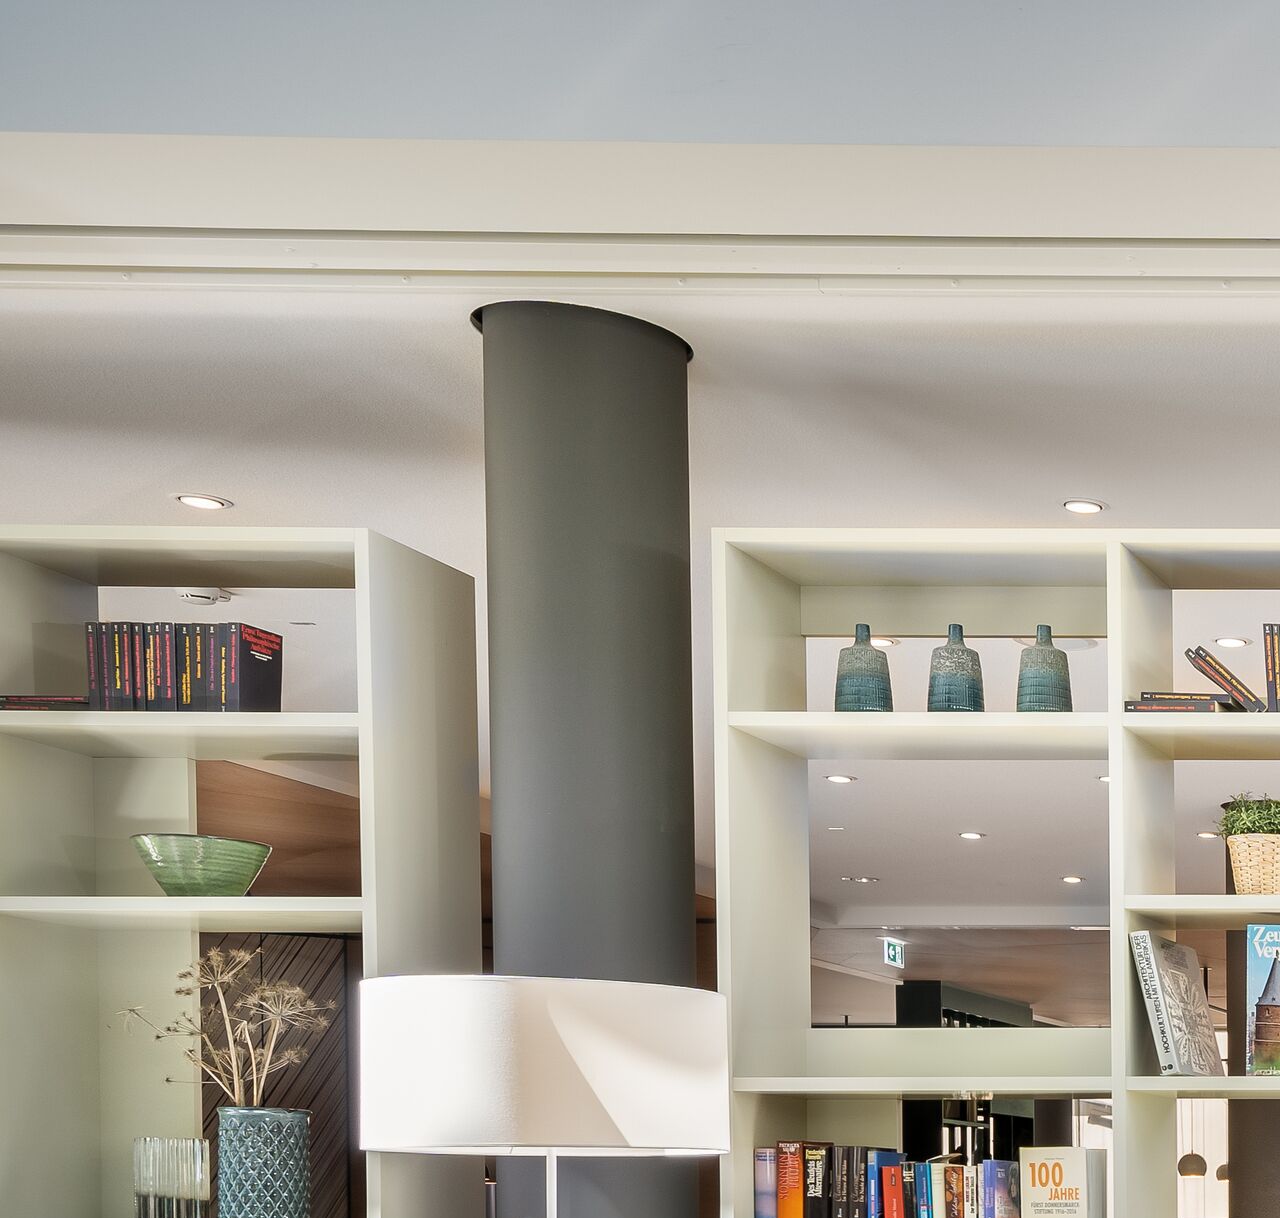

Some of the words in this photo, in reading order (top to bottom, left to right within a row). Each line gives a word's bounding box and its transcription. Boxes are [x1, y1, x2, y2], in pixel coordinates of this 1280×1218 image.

[1134, 935, 1142, 951] DER
[1137, 951, 1152, 1000] ARCHITEKTUR
[1140, 934, 1159, 997] MITTELAMERIKAS
[1153, 996, 1171, 1054] HOCHKULTUREN
[807, 1161, 815, 1184] Teufels
[815, 1160, 823, 1198] Alternative
[1029, 1162, 1064, 1188] 100
[1048, 1187, 1080, 1201] JAHRE
